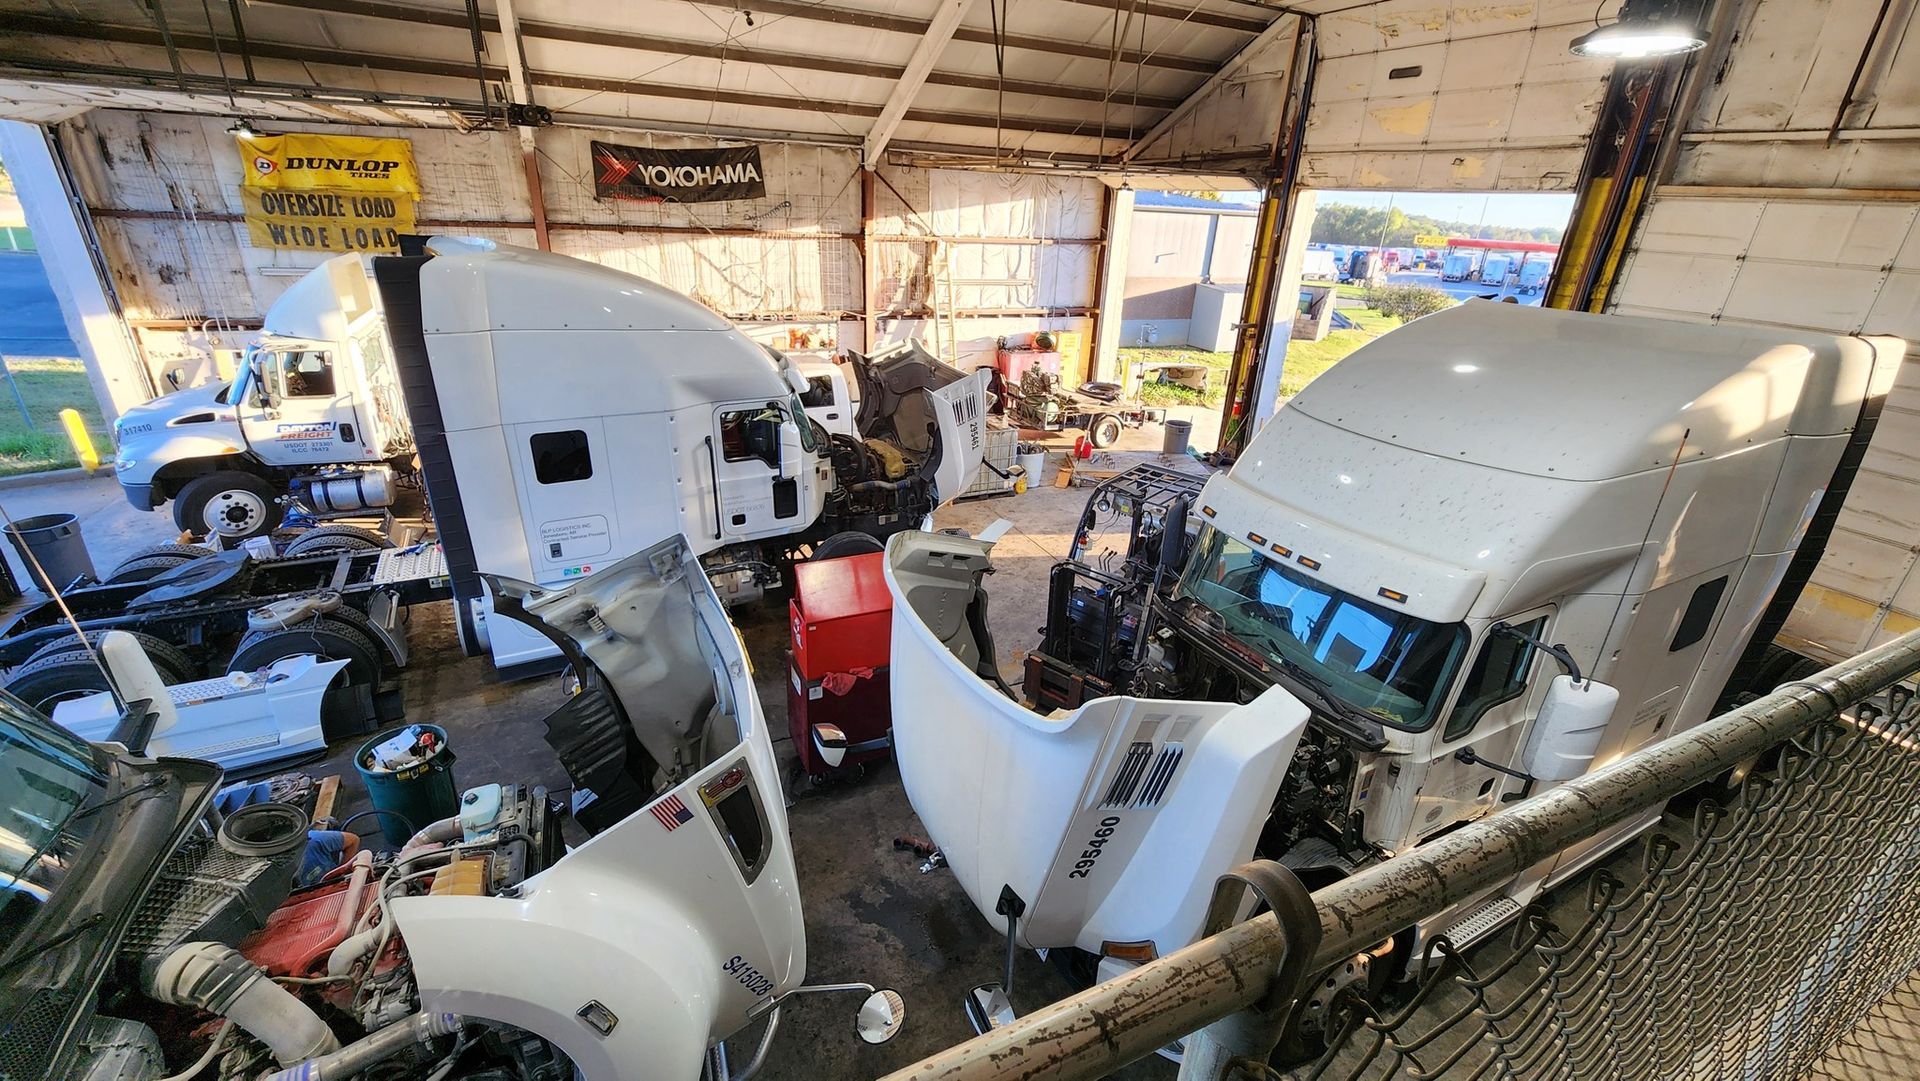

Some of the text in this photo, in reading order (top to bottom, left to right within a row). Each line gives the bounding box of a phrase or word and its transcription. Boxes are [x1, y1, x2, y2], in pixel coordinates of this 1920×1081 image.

[285, 157, 399, 173] DUNLOP
[638, 162, 761, 187] YOKOHAMA
[261, 192, 396, 218] OVERSIZE LOAD
[266, 223, 399, 249] WIDE LOAD
[124, 423, 152, 435] 317410
[970, 422, 979, 450] 295461
[1069, 816, 1120, 878] 295460
[722, 955, 774, 996] S415028
